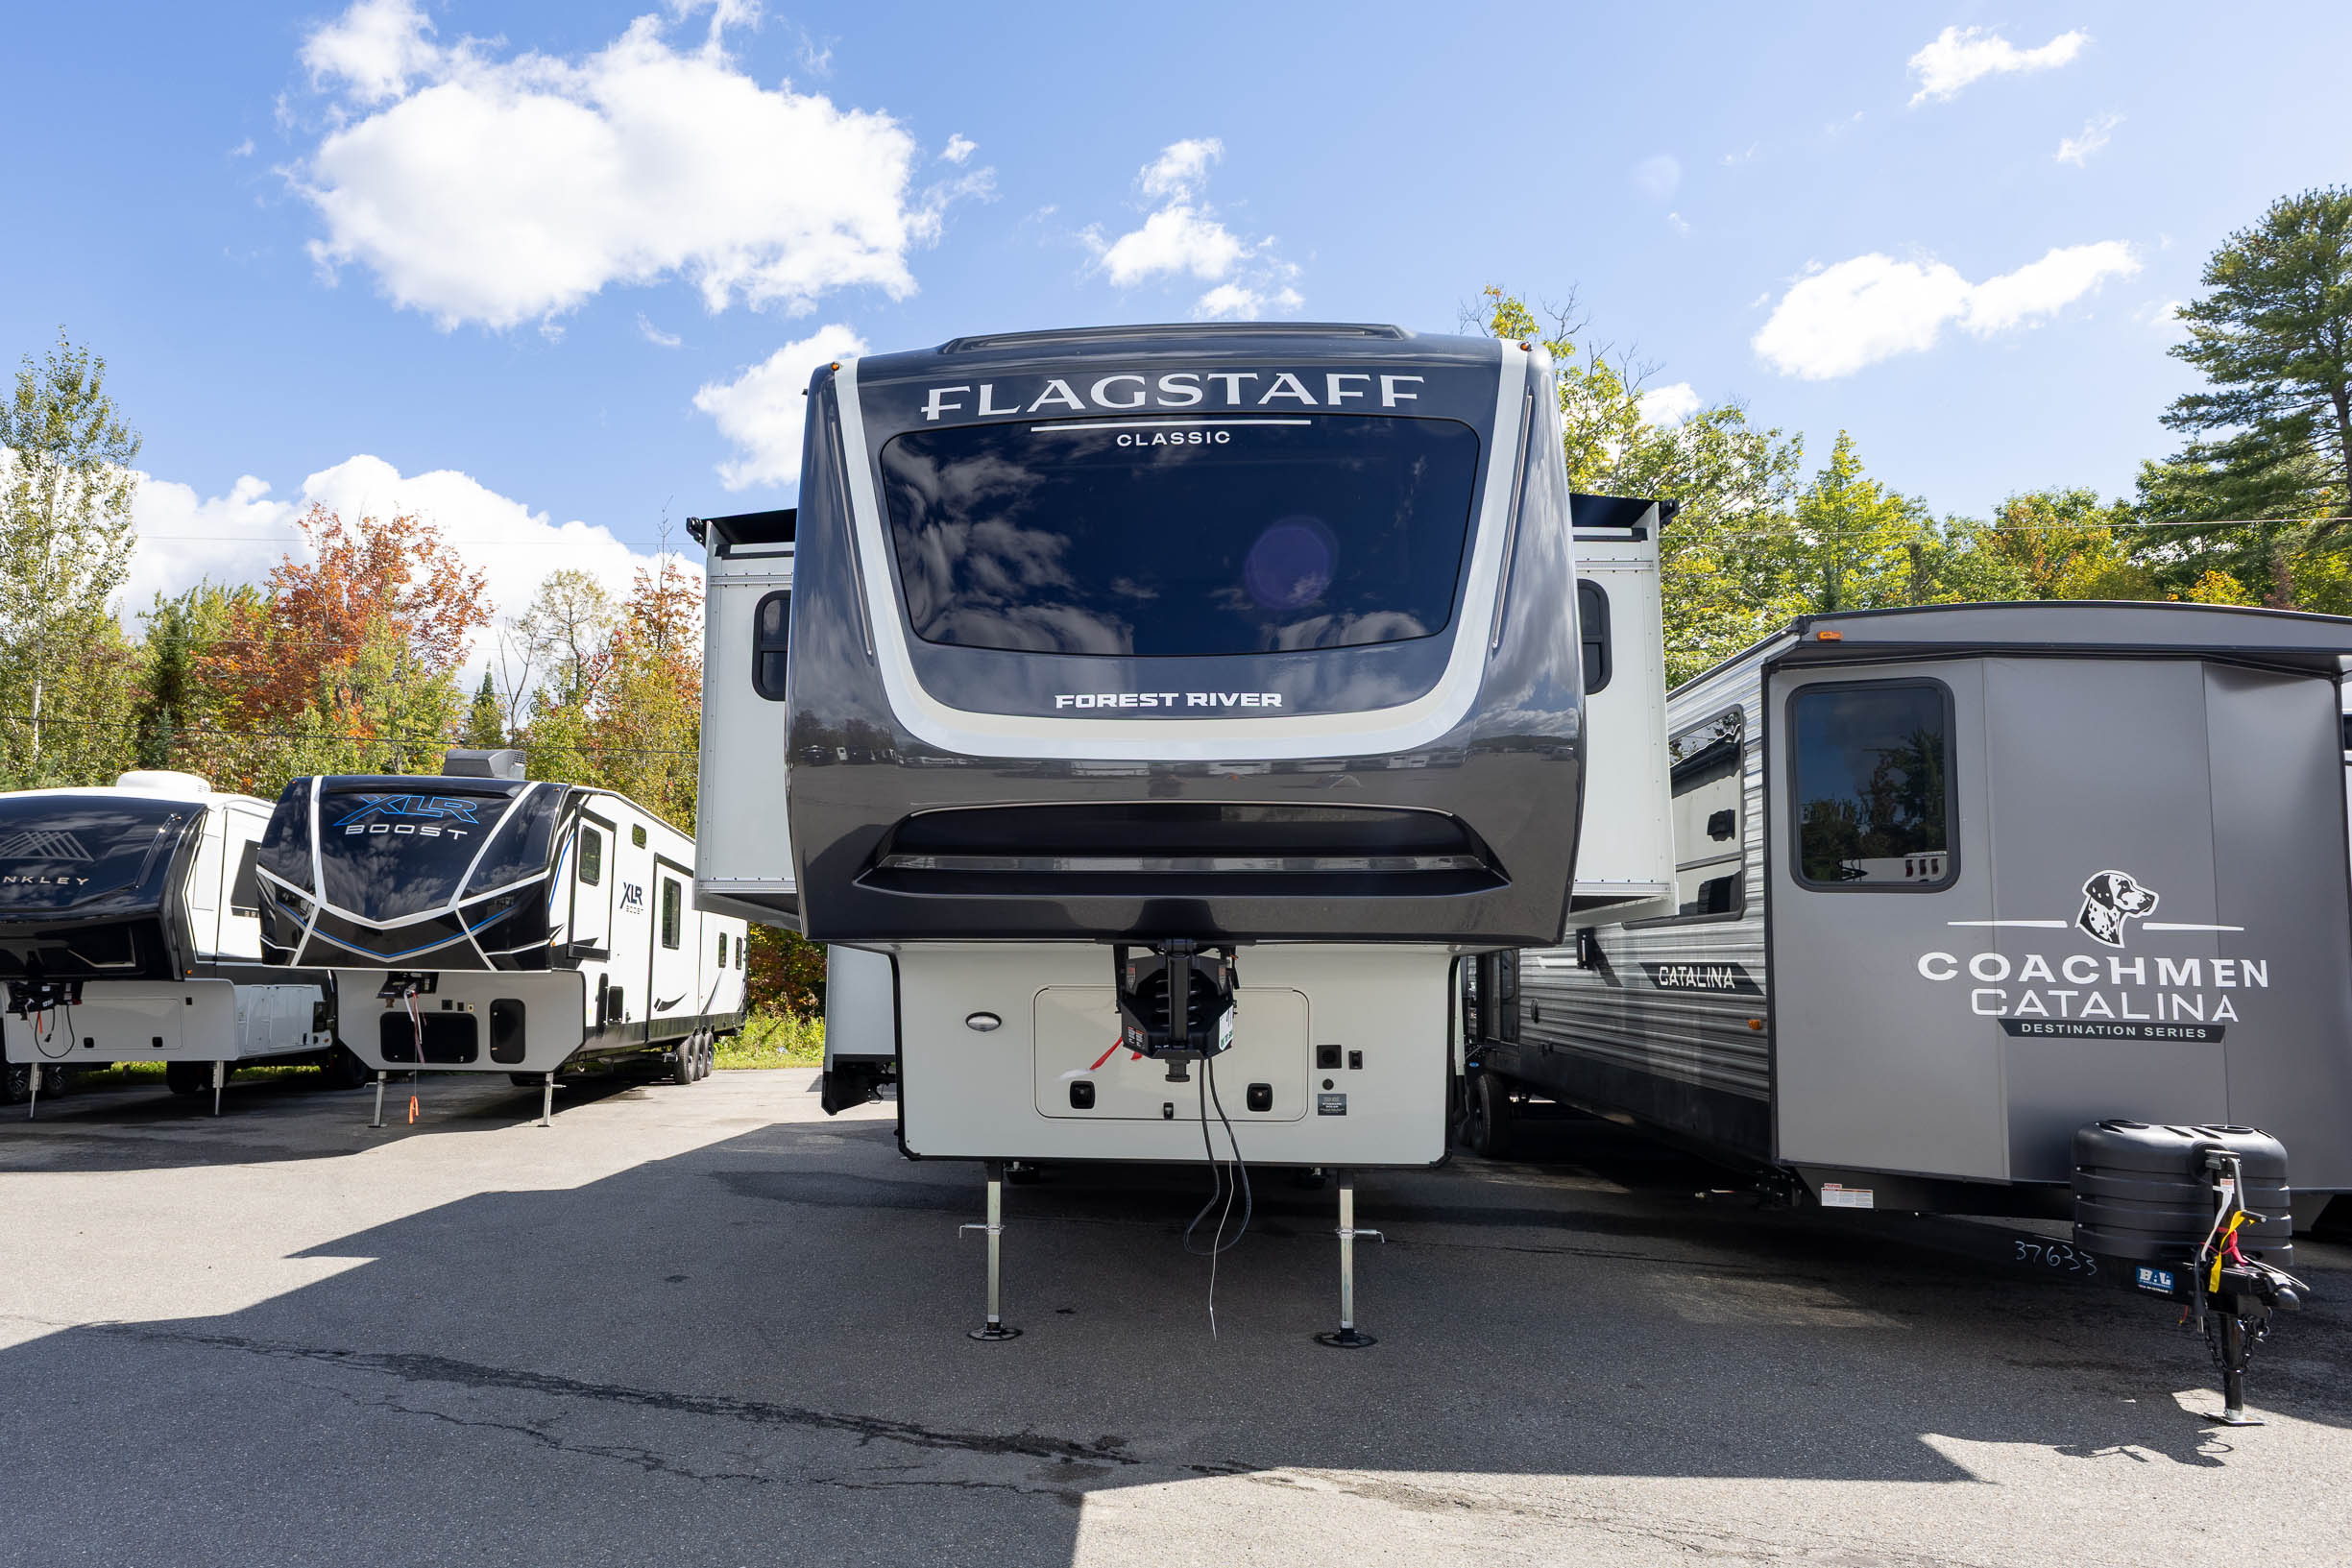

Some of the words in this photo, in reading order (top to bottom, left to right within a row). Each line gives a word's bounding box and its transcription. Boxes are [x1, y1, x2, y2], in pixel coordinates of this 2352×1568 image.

[921, 373, 1424, 421] FLAGSTAFF
[1116, 430, 1231, 446] CLASSIC
[1055, 693, 1179, 709] FOREST
[1185, 692, 1283, 708] RIVER
[332, 794, 479, 827] XLR
[345, 824, 468, 840] BOOST
[619, 881, 643, 909] XLR
[1659, 966, 1735, 989] CATALINA
[1917, 952, 2268, 988] COACHMEN
[1971, 988, 2240, 1023] CATALINA
[2021, 1023, 2137, 1037] DESTINATION
[2144, 1026, 2207, 1039] SERIES
[2014, 1241, 2097, 1276] 37633
